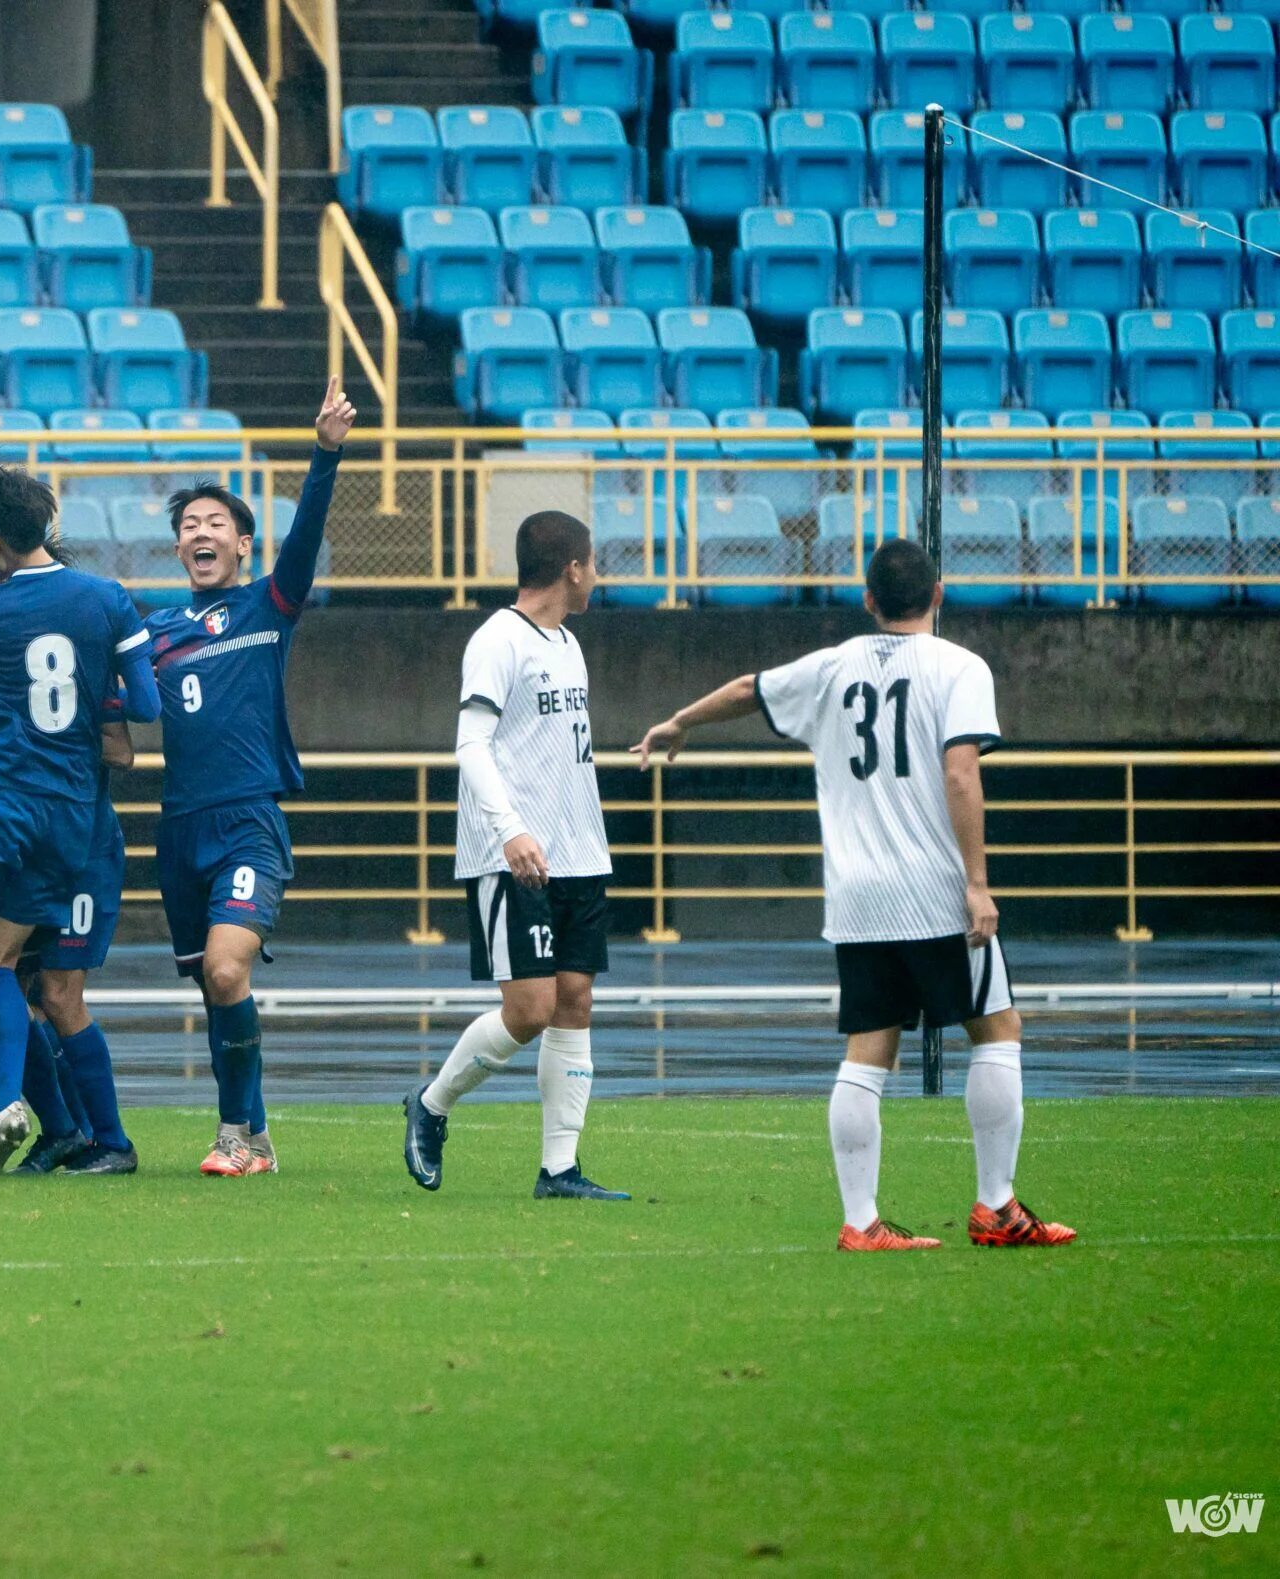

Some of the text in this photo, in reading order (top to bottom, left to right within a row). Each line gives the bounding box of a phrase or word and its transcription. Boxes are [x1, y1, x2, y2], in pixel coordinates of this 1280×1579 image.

[25, 633, 78, 733] 8
[181, 674, 202, 713] 9
[537, 690, 562, 715] BE
[573, 723, 593, 763] 12
[843, 678, 910, 781] 31
[232, 866, 255, 900] 9
[60, 893, 93, 935] 0
[528, 925, 553, 958] 12
